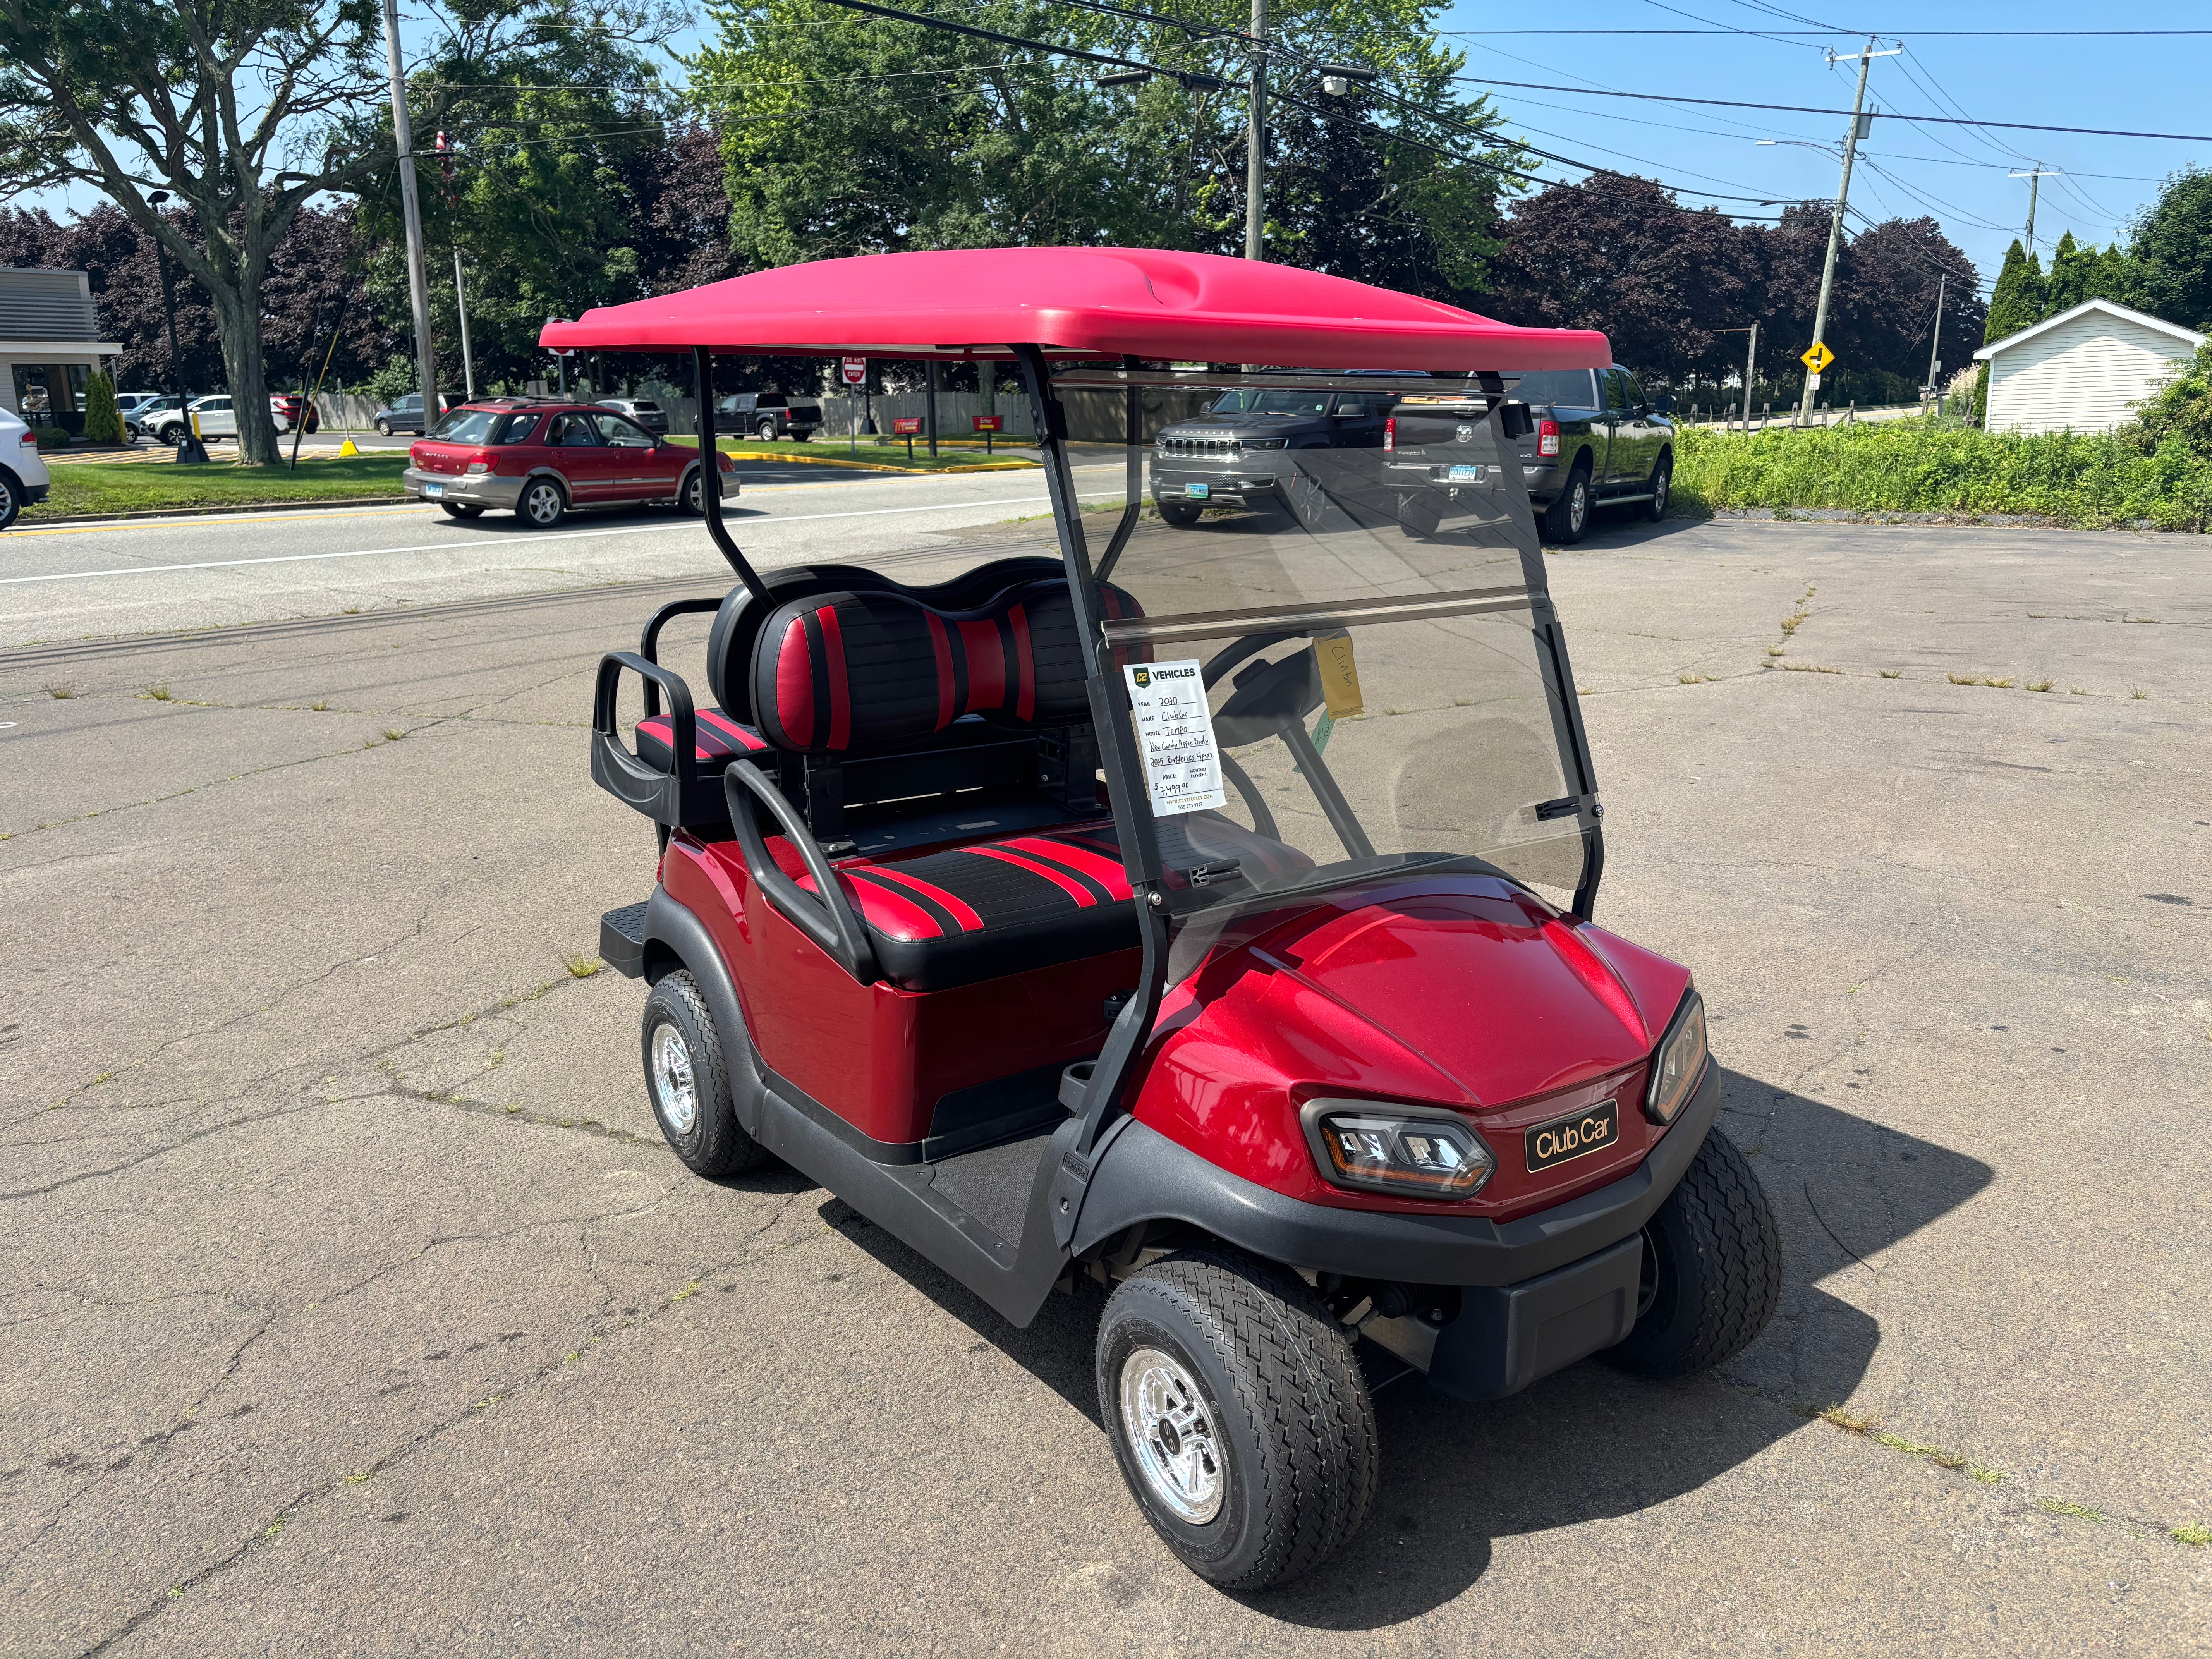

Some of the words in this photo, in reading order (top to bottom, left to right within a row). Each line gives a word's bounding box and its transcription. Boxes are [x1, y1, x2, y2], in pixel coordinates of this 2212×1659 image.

[1137, 672, 1147, 682] C2
[1152, 668, 1195, 680] VEHICLES
[1159, 697, 1178, 706] 2020
[1162, 740, 1178, 750] Candy
[1179, 739, 1193, 749] Apple
[1194, 735, 1209, 745] Body
[1537, 1126, 1579, 1158] Club
[1580, 1117, 1609, 1143] Car
